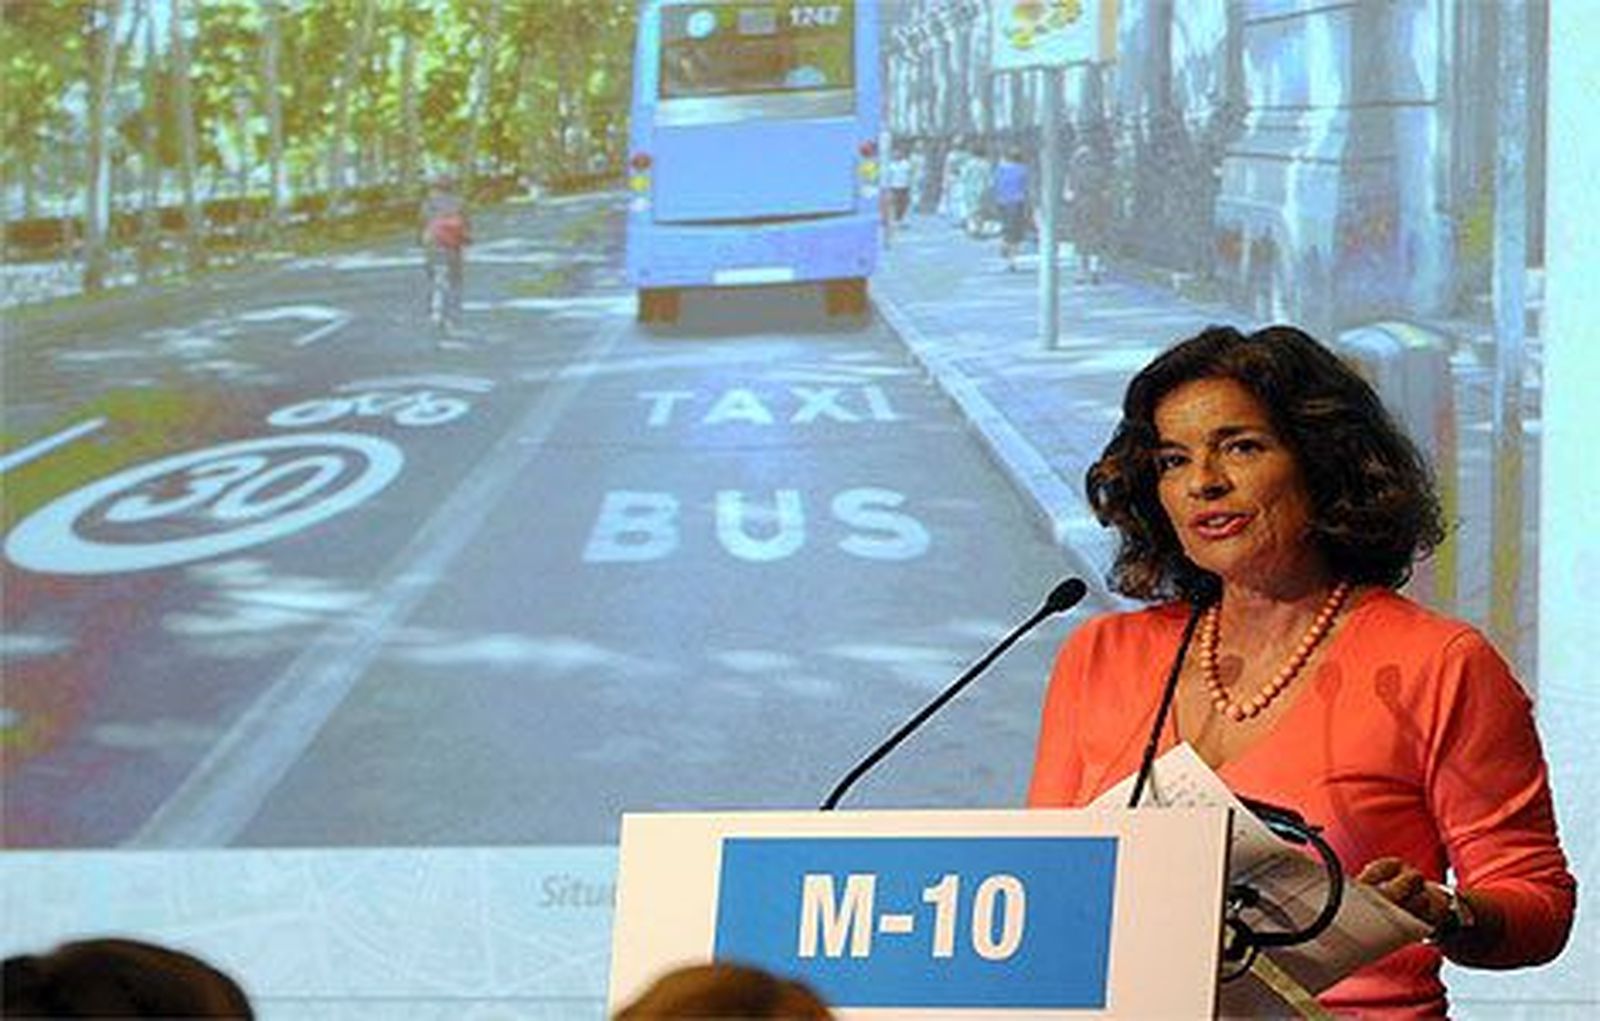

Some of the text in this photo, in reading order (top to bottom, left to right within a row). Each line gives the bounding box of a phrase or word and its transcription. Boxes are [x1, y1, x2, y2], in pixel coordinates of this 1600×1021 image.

[638, 385, 901, 427] TAXI
[106, 455, 343, 521] 30
[582, 487, 931, 562] BUS
[797, 873, 1026, 961] M-10
